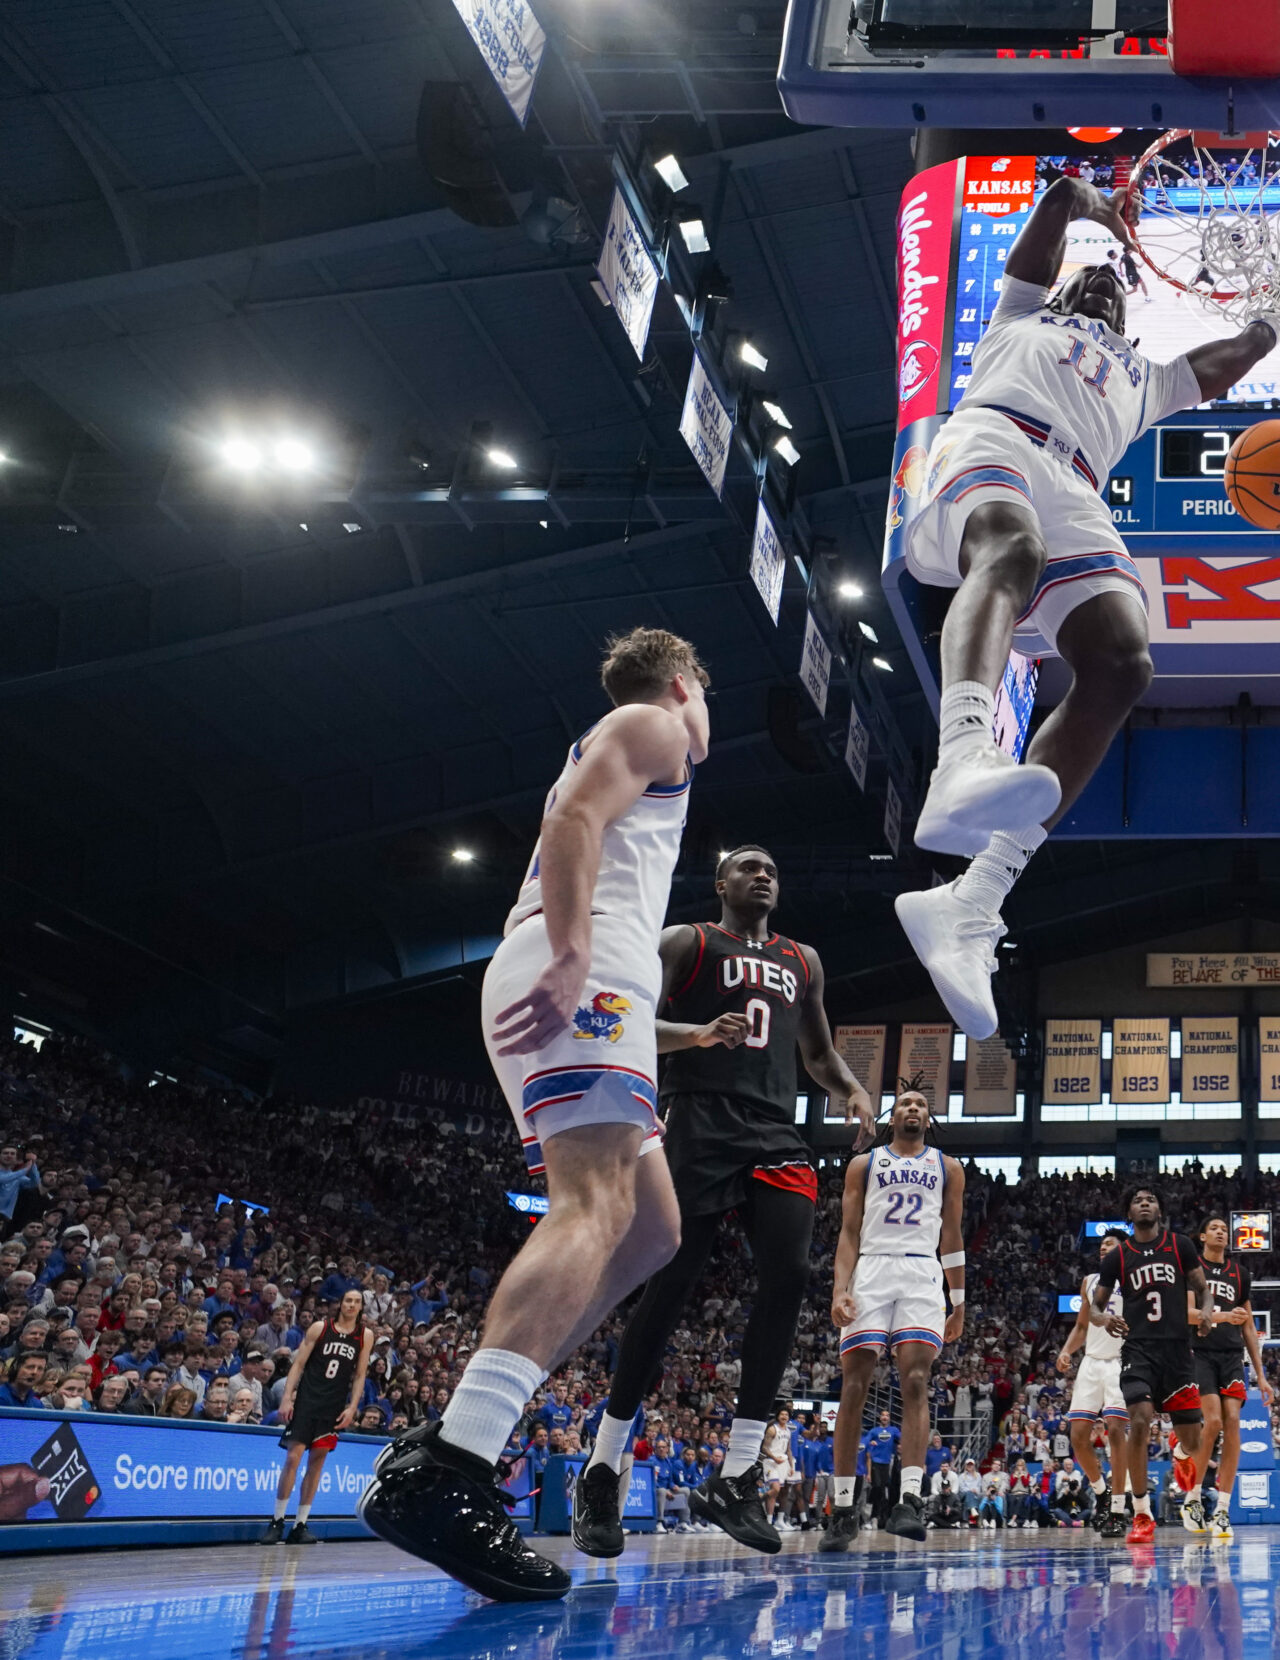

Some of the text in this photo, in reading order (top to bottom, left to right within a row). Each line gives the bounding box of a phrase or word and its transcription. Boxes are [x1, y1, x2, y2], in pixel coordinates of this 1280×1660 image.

[967, 180, 1032, 194] KANSAS
[977, 203, 1010, 213] FOULS
[992, 224, 1016, 234] PTS
[967, 249, 1006, 261] 3 2
[900, 191, 939, 338] Wendy's
[965, 280, 975, 292] 7
[960, 309, 976, 322] 11
[955, 343, 973, 356] 15
[1041, 316, 1142, 389] KANSAS
[1058, 334, 1113, 399] 11
[1054, 438, 1071, 454] KU
[1111, 479, 1131, 502] 4
[1182, 499, 1240, 516] PERIO
[1113, 509, 1141, 523] O.L.
[721, 956, 797, 1004] UTES
[1173, 968, 1222, 985] BEWARE
[1231, 969, 1248, 982] OF
[591, 1016, 608, 1028] KU
[745, 998, 771, 1049] 0
[1053, 1033, 1095, 1043] NATIONAL
[1120, 1032, 1163, 1042] NATIONAL
[1189, 1031, 1232, 1041] NATIONAL
[1046, 1046, 1099, 1056] CHAMPIONS
[1114, 1045, 1168, 1056] CHAMPIONS
[1183, 1044, 1238, 1055] CHAMPIONS
[1053, 1077, 1091, 1093] 1922
[1122, 1076, 1159, 1092] 1923
[1192, 1075, 1230, 1091] 1952
[876, 1169, 938, 1190] KANSAS
[884, 1191, 923, 1226] 22
[1237, 1226, 1264, 1248] 26
[1129, 1263, 1176, 1292] UTES
[1205, 1280, 1236, 1302] TES
[1146, 1291, 1162, 1322] 3
[322, 1341, 356, 1361] UTES
[325, 1359, 340, 1379] 8
[113, 1453, 188, 1492] Score
[193, 1467, 248, 1492] more
[254, 1461, 296, 1491] wit
